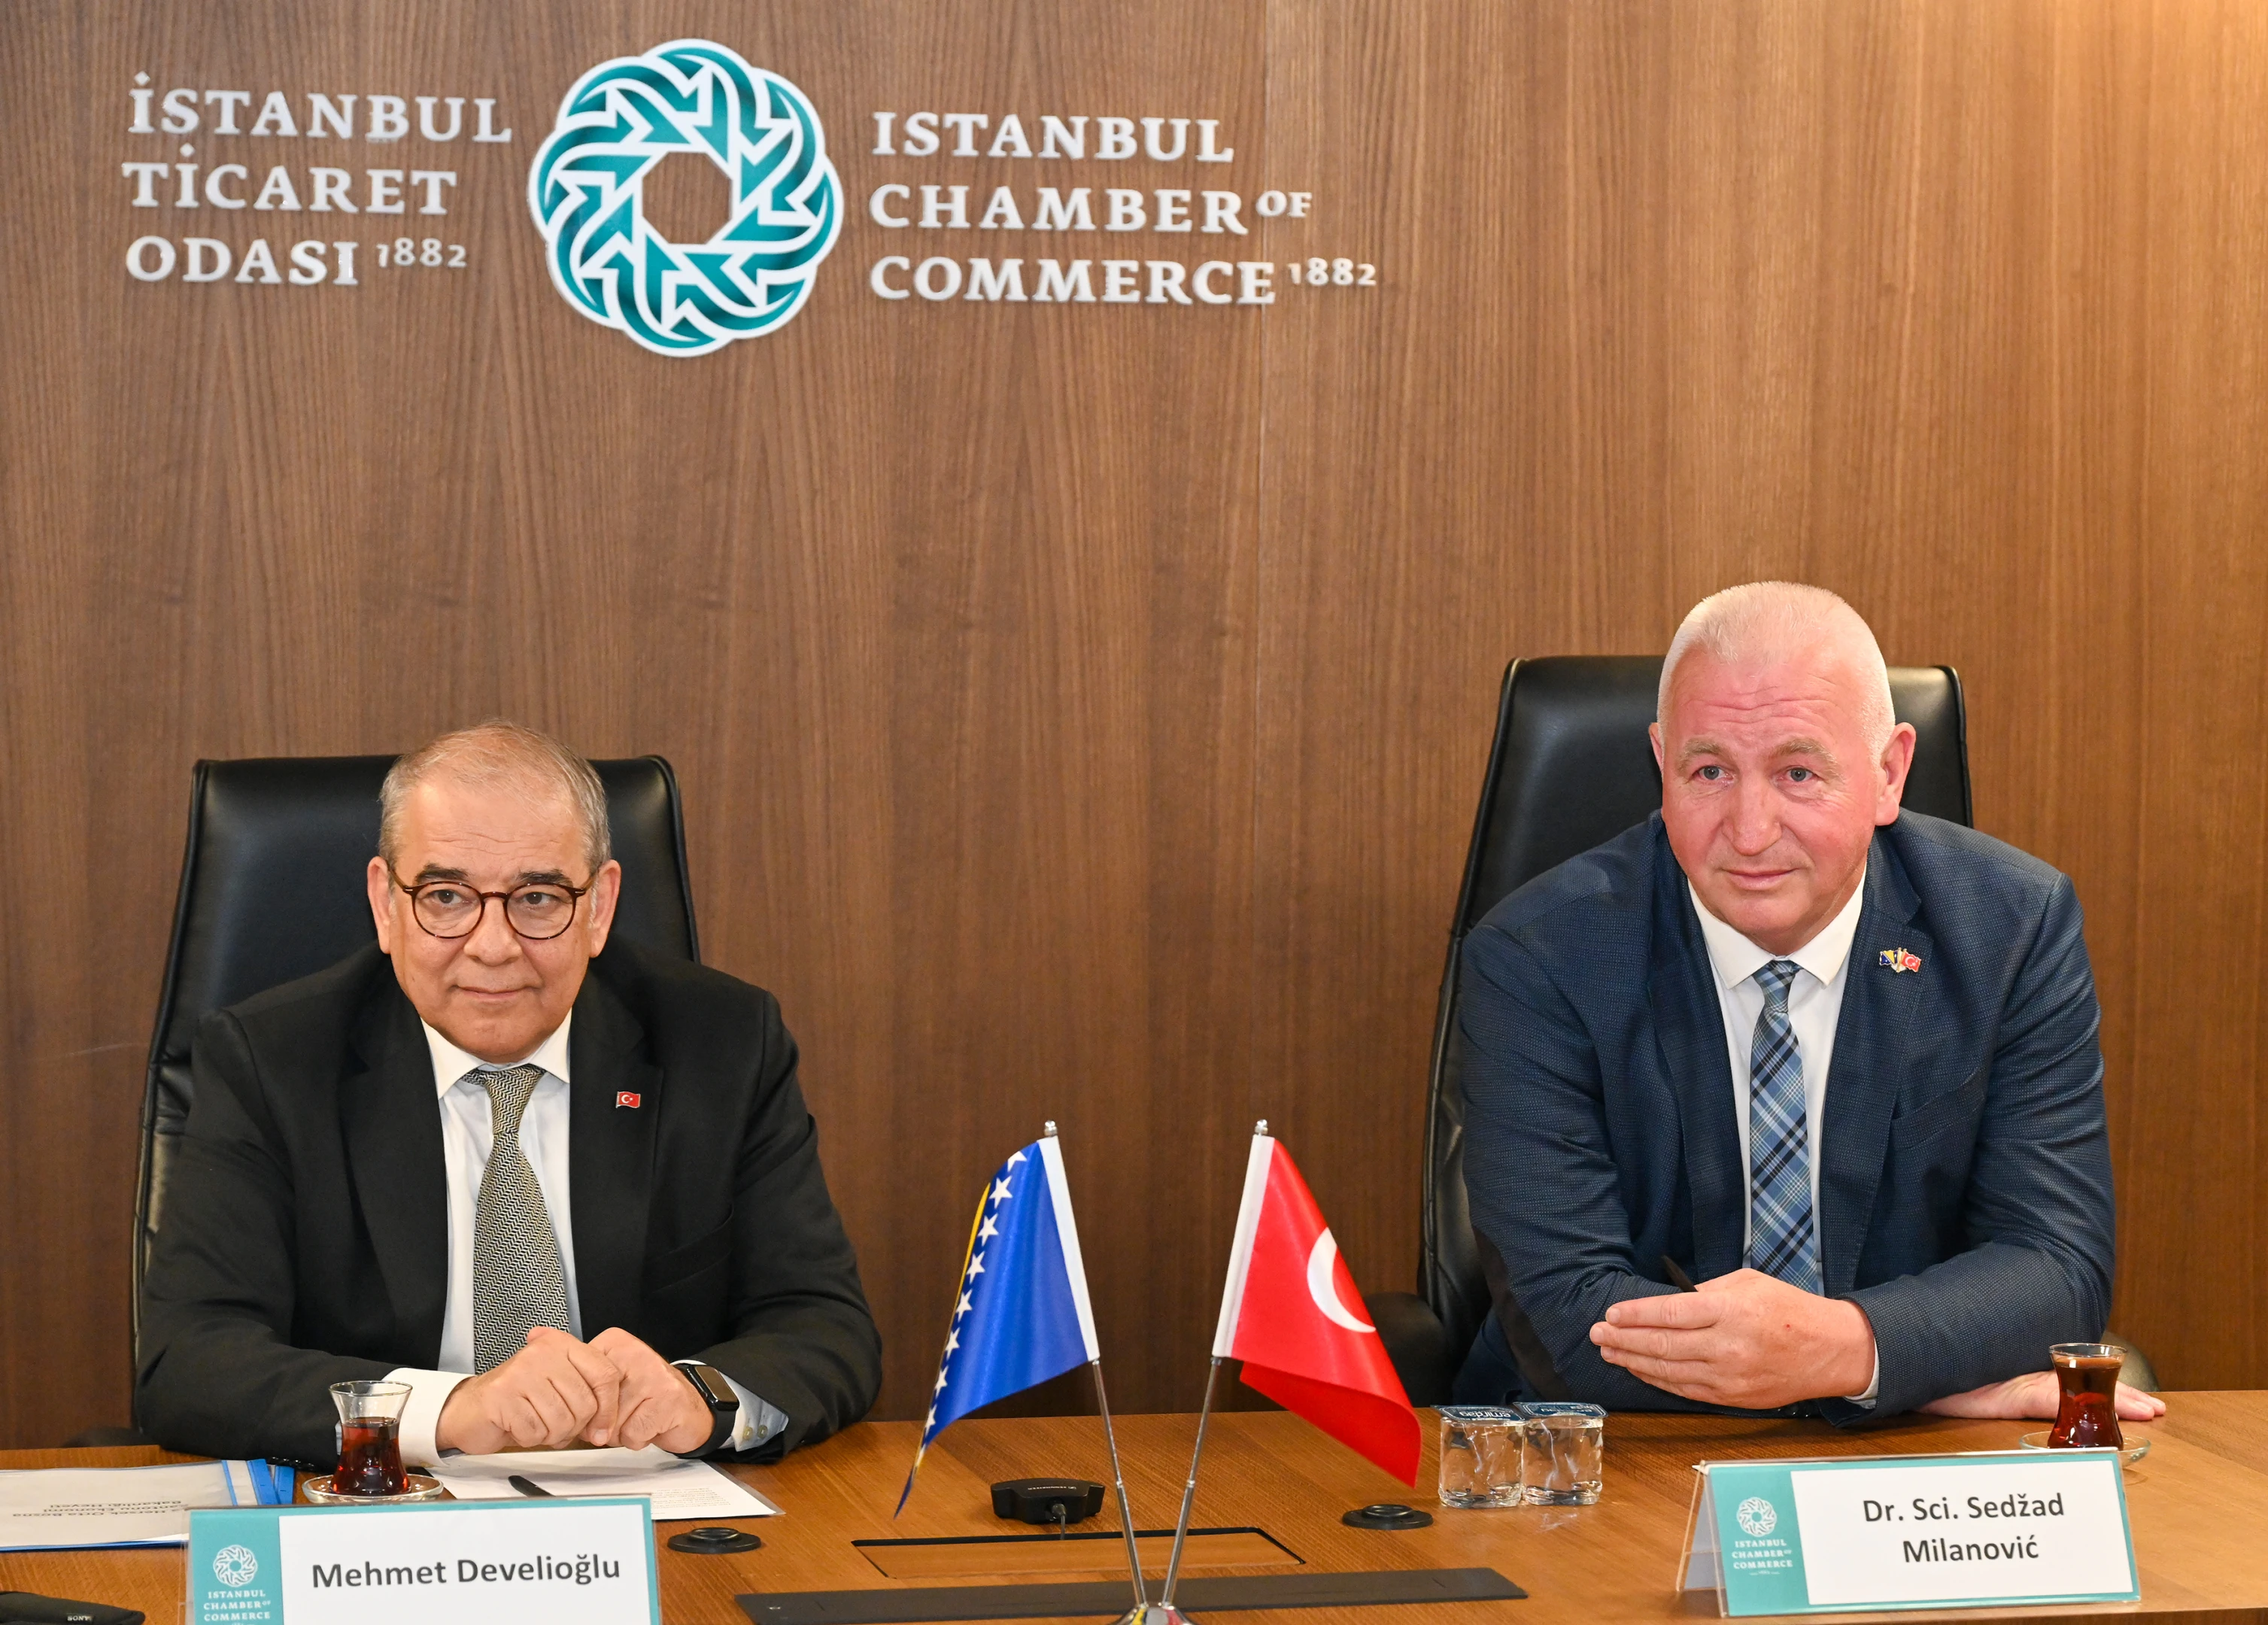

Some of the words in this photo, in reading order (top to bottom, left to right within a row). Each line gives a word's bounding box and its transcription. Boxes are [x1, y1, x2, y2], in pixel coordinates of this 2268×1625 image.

[128, 71, 512, 143] İSTANBUL
[873, 111, 1234, 162] ISTANBUL
[122, 144, 457, 214] TİCARET
[870, 184, 1248, 235] CHAMBER
[1256, 190, 1313, 218] OF
[126, 235, 359, 285] ODASI
[376, 238, 467, 268] 1882
[870, 256, 1276, 305] COMMERCE
[1288, 257, 1377, 286] 1882
[1863, 1499, 1903, 1522] Dr.
[1912, 1496, 1958, 1520] Sci.
[1967, 1493, 2064, 1519] Sedžad
[1731, 1550, 1784, 1559] CHAMBER
[1734, 1538, 1787, 1548] ISTANBUL
[1902, 1534, 2039, 1563] Milanović
[313, 1561, 447, 1588] Mehmet
[457, 1554, 620, 1585] Develioğlu
[1732, 1560, 1793, 1569] COMMERCE
[203, 1601, 261, 1611] CHAMBER
[208, 1590, 266, 1599] ISTANBUL
[203, 1611, 271, 1622] COMMERCE
